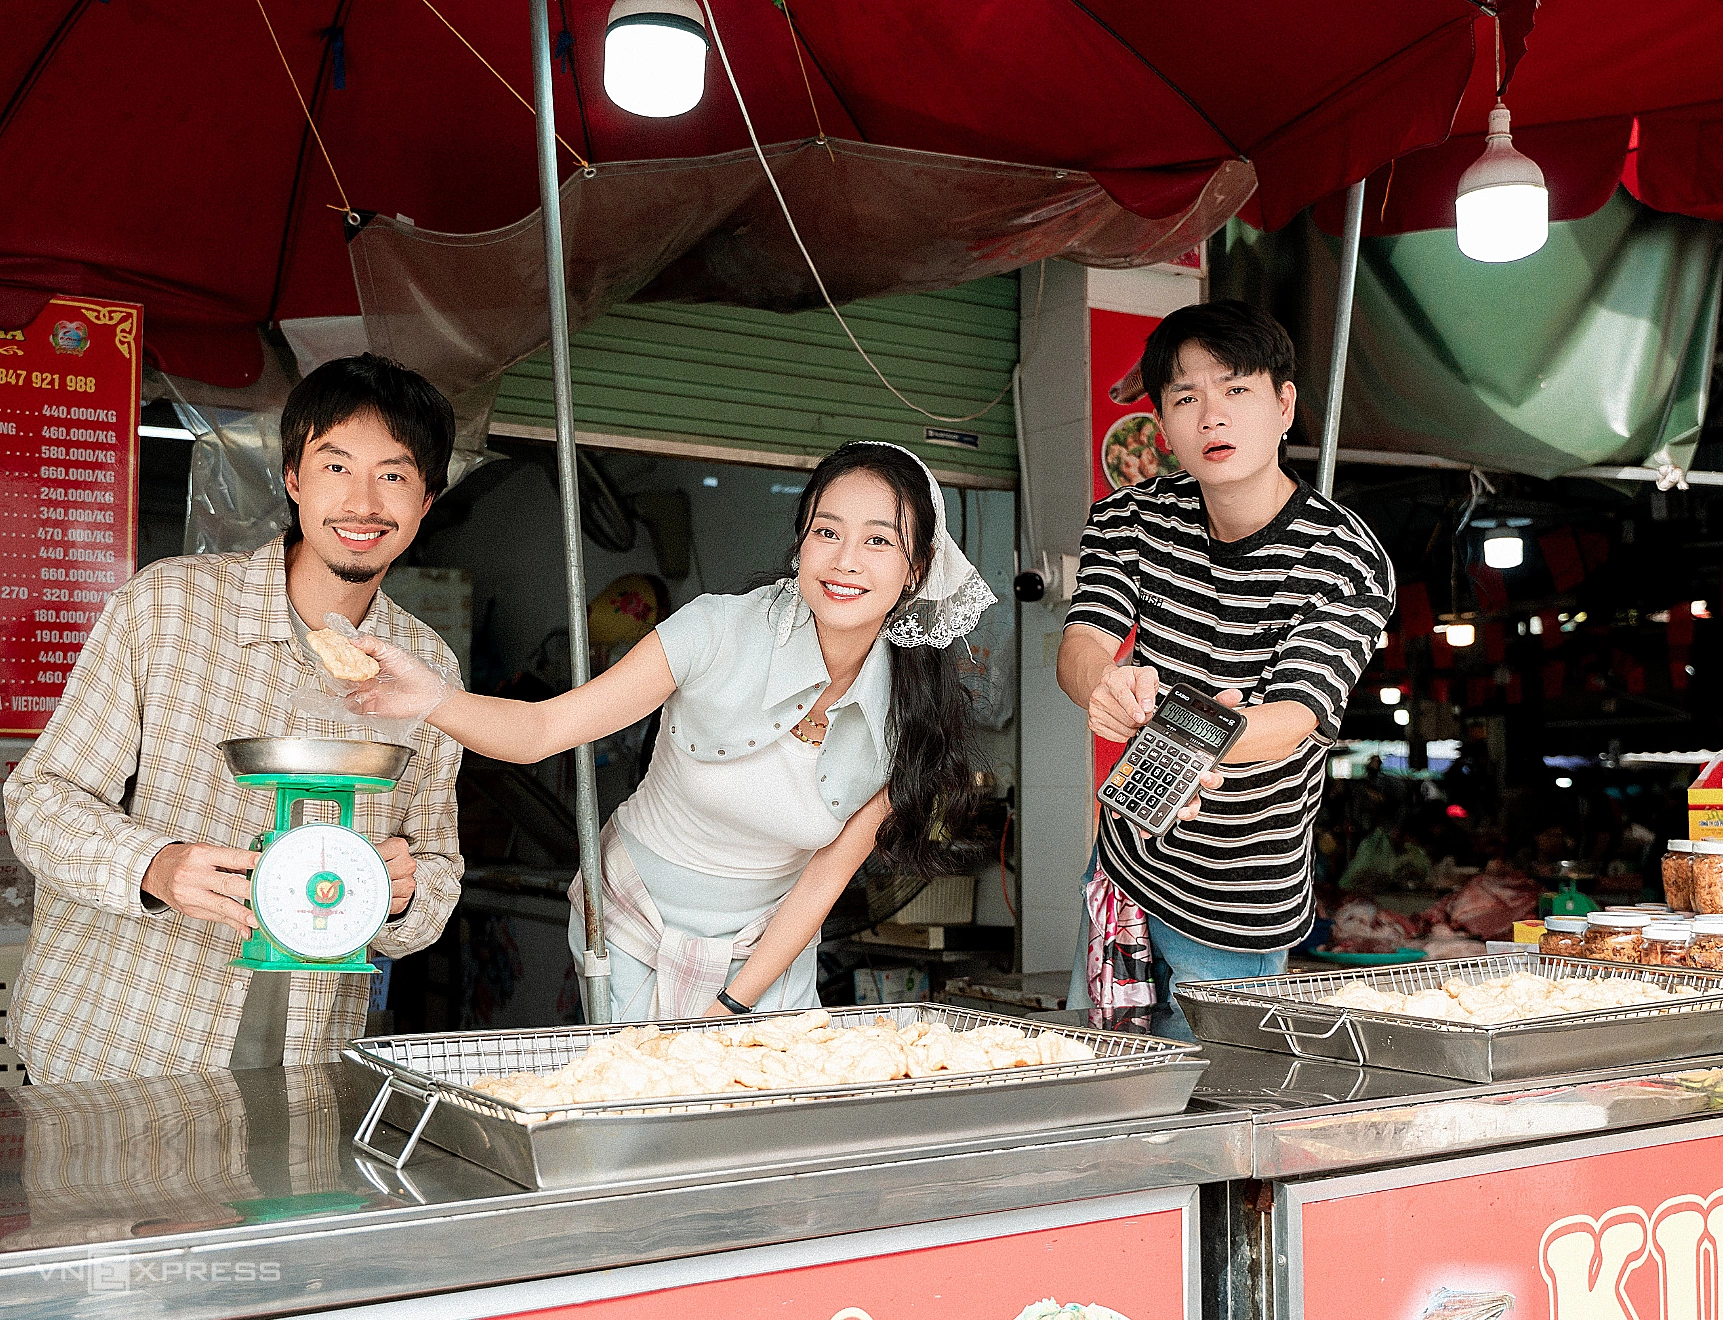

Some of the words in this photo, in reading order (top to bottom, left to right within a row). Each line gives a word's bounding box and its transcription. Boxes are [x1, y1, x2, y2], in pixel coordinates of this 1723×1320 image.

[32, 371, 59, 389] 921
[66, 375, 95, 393] 988
[1, 585, 29, 599] 270
[1174, 690, 1191, 702] CASIO
[1122, 765, 1130, 773] C
[1134, 773, 1142, 781] 4
[1145, 779, 1154, 787] 5
[1156, 786, 1165, 794] 6
[1142, 761, 1151, 769] 7
[1153, 768, 1161, 776] 8
[1165, 775, 1173, 783] 9
[1105, 787, 1114, 795] 0
[1116, 793, 1126, 803] 00
[1126, 783, 1134, 792] 1
[1136, 790, 1145, 799] 2
[1148, 797, 1157, 806] 3
